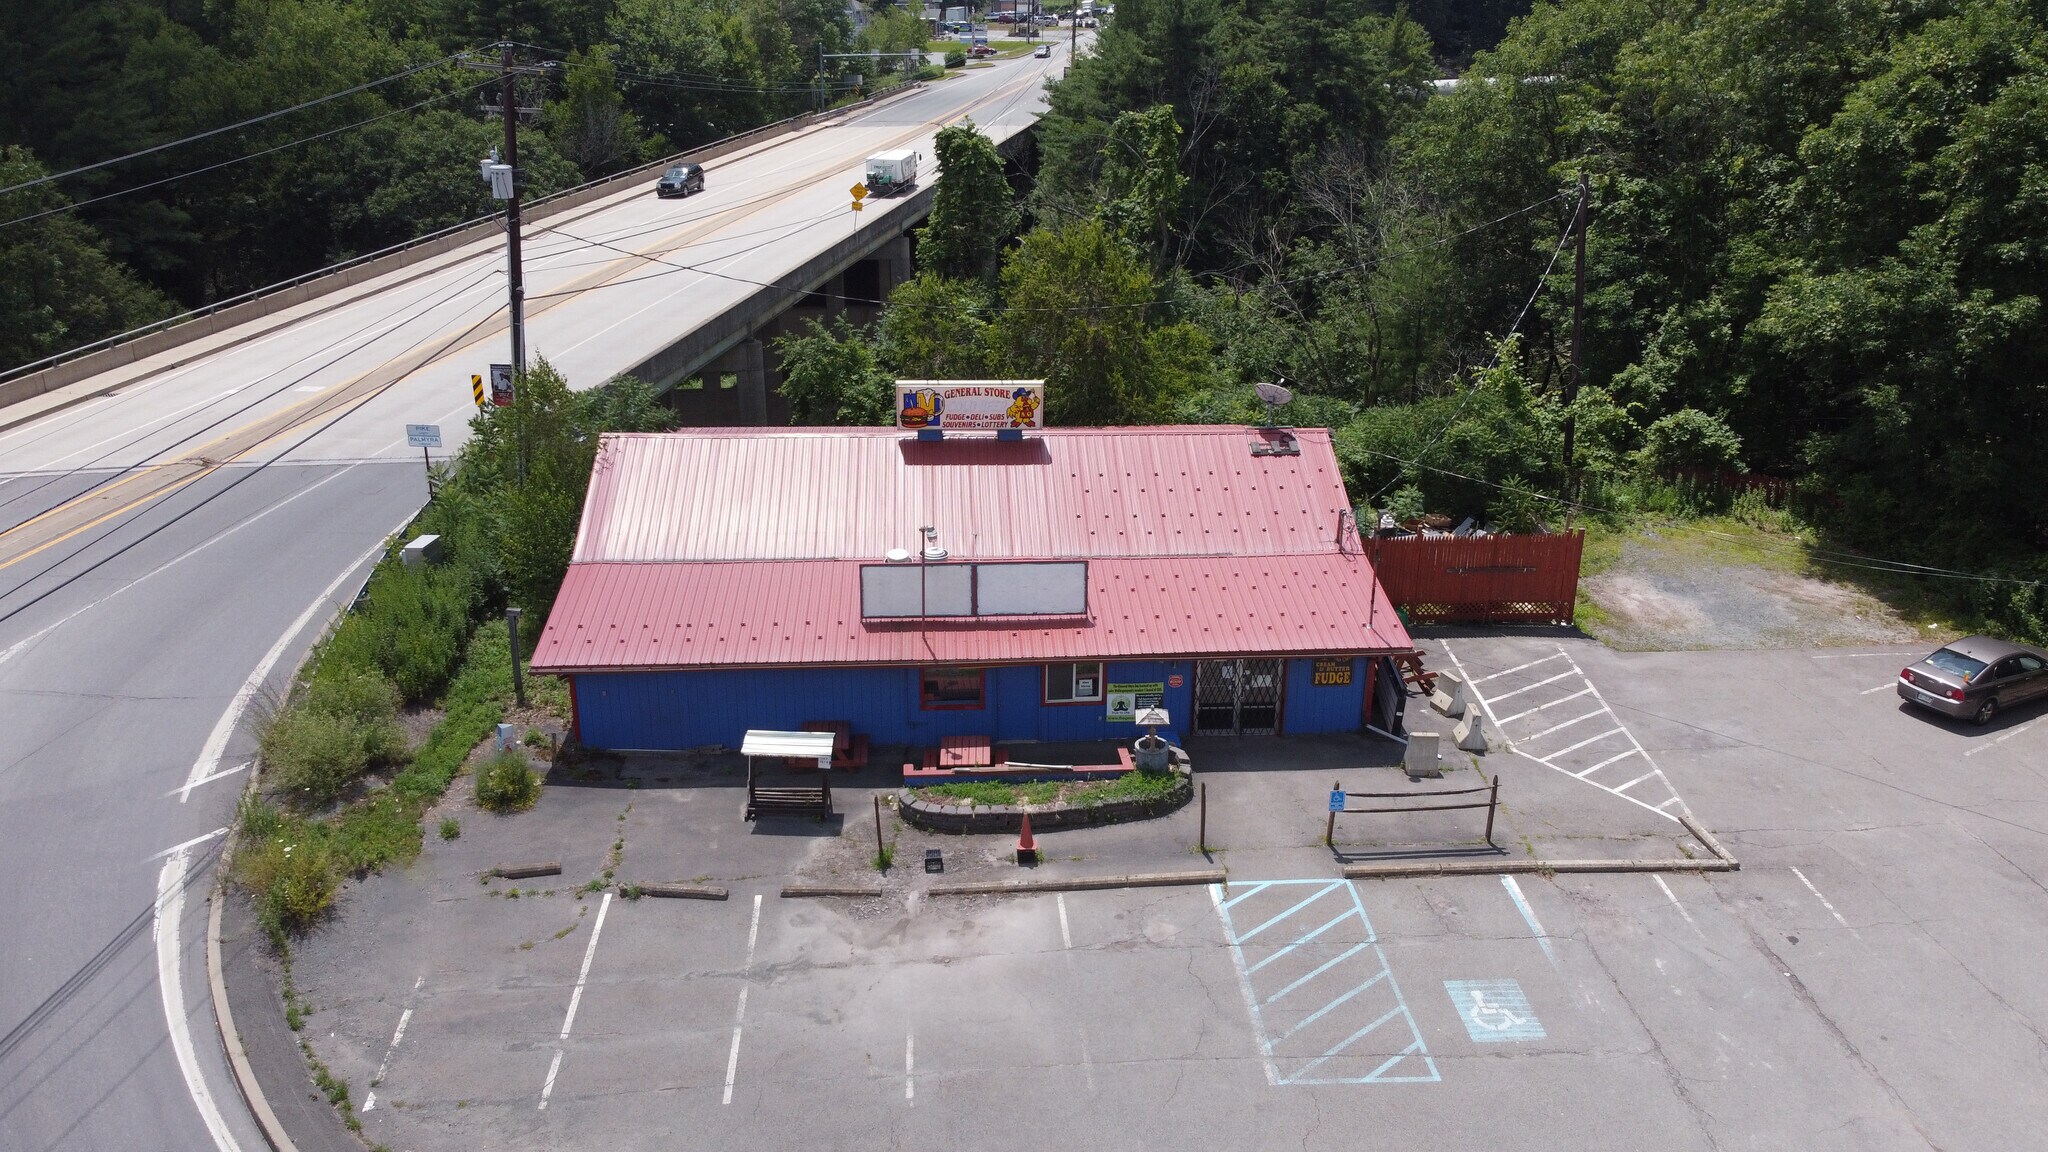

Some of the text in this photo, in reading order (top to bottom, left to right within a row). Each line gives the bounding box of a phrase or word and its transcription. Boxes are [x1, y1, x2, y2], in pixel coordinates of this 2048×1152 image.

[945, 387, 1011, 399] GENERAL STORE
[1315, 672, 1351, 684] FUDGE
